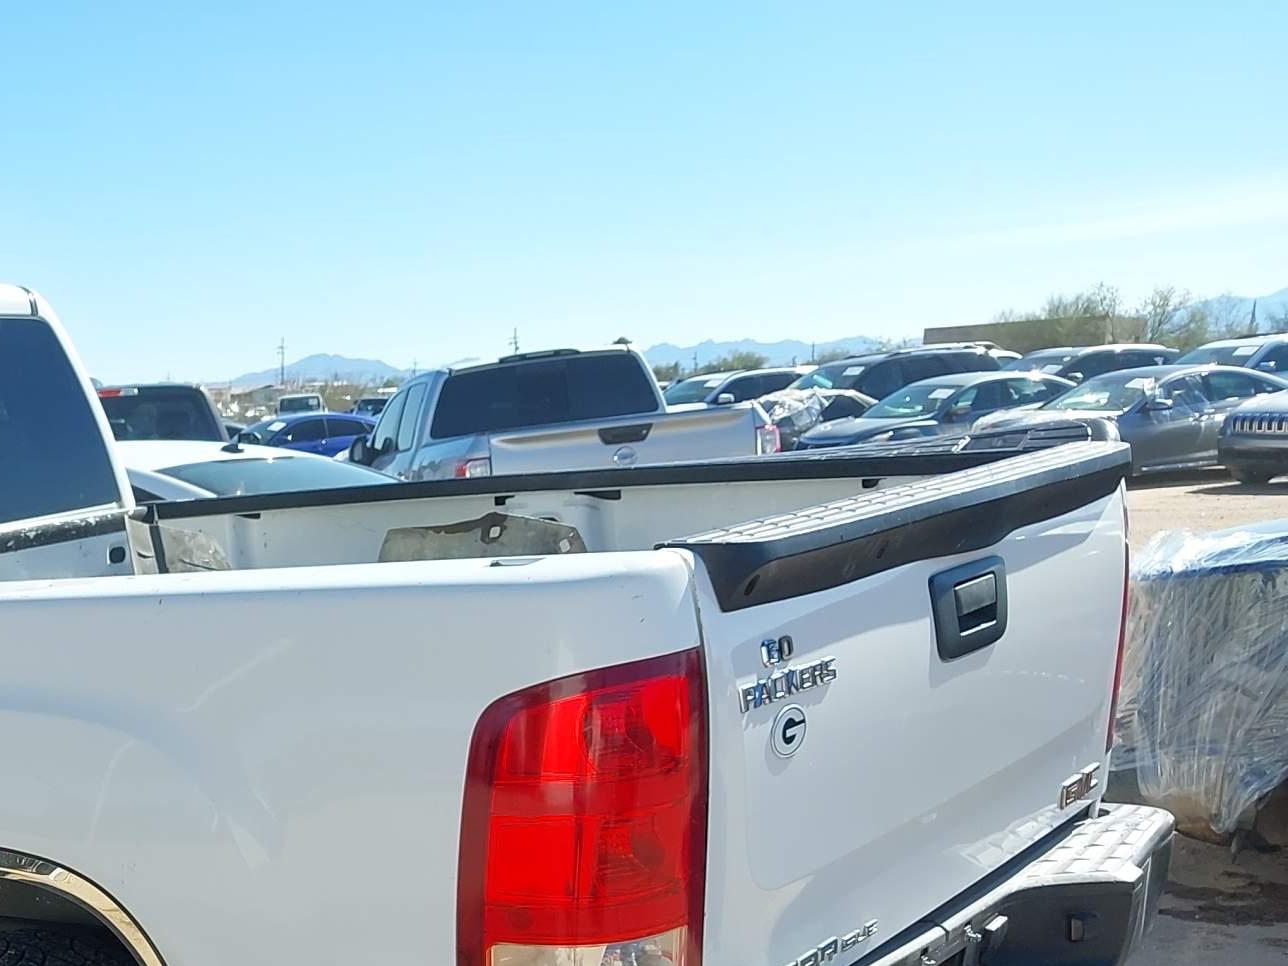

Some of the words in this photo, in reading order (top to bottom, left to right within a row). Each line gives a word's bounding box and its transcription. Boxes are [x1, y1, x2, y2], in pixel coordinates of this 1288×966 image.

[760, 635, 793, 668] GO
[737, 655, 838, 714] PACKERS
[772, 704, 807, 757] G
[1058, 761, 1101, 810] GMC
[840, 918, 880, 952] SLE
